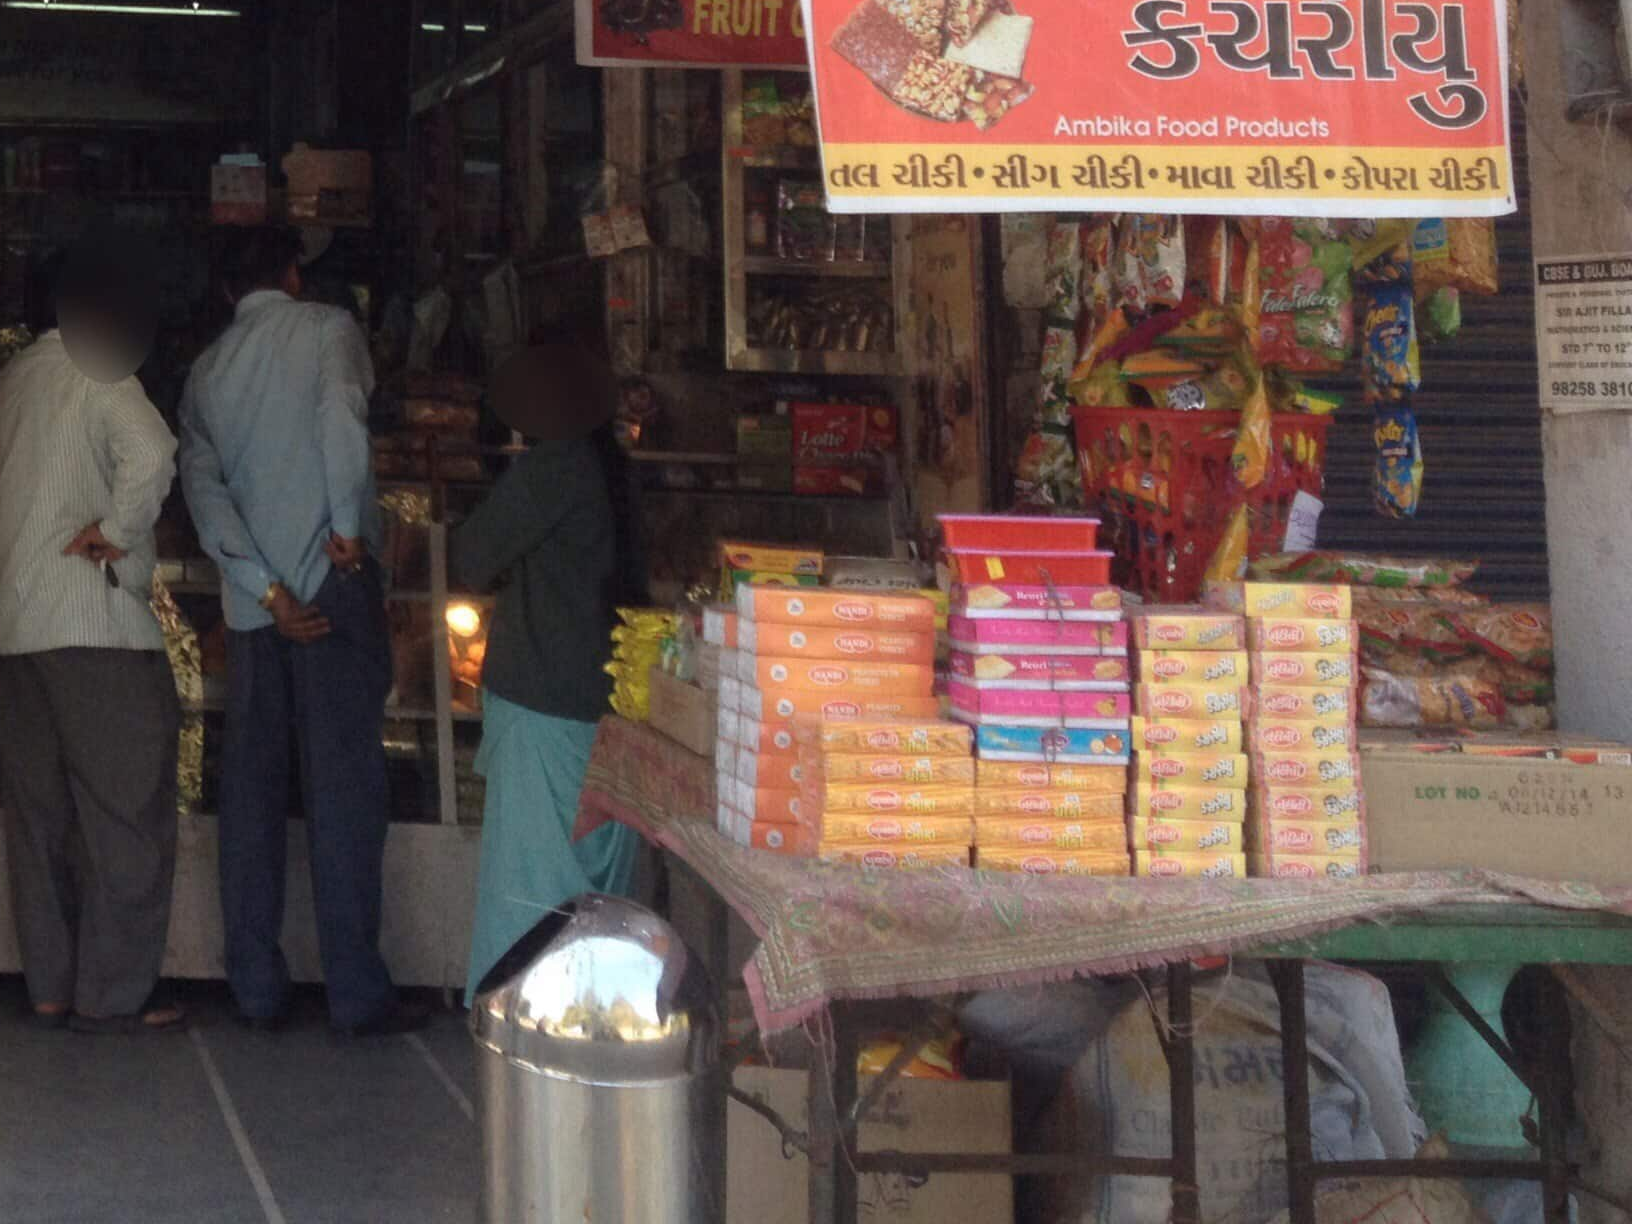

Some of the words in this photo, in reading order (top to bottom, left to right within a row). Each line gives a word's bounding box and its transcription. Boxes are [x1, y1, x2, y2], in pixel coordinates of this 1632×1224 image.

[1054, 115, 1150, 136] Ambika
[1158, 116, 1218, 137] Food
[1227, 116, 1329, 137] Products
[830, 162, 880, 189] તલ
[892, 152, 969, 189] ચીકી
[1072, 153, 1145, 189] ચીકી
[1166, 164, 1236, 190] માવા
[1246, 155, 1320, 190] ચીકી
[1342, 155, 1420, 191] કોપરા
[1429, 156, 1501, 191] ચીકી
[1575, 307, 1599, 318] AJIT
[1561, 343, 1581, 355] STD
[1598, 343, 1612, 354] TO
[1551, 382, 1596, 397] 98258
[1415, 786, 1446, 800] LOT
[1456, 786, 1481, 800] NO
